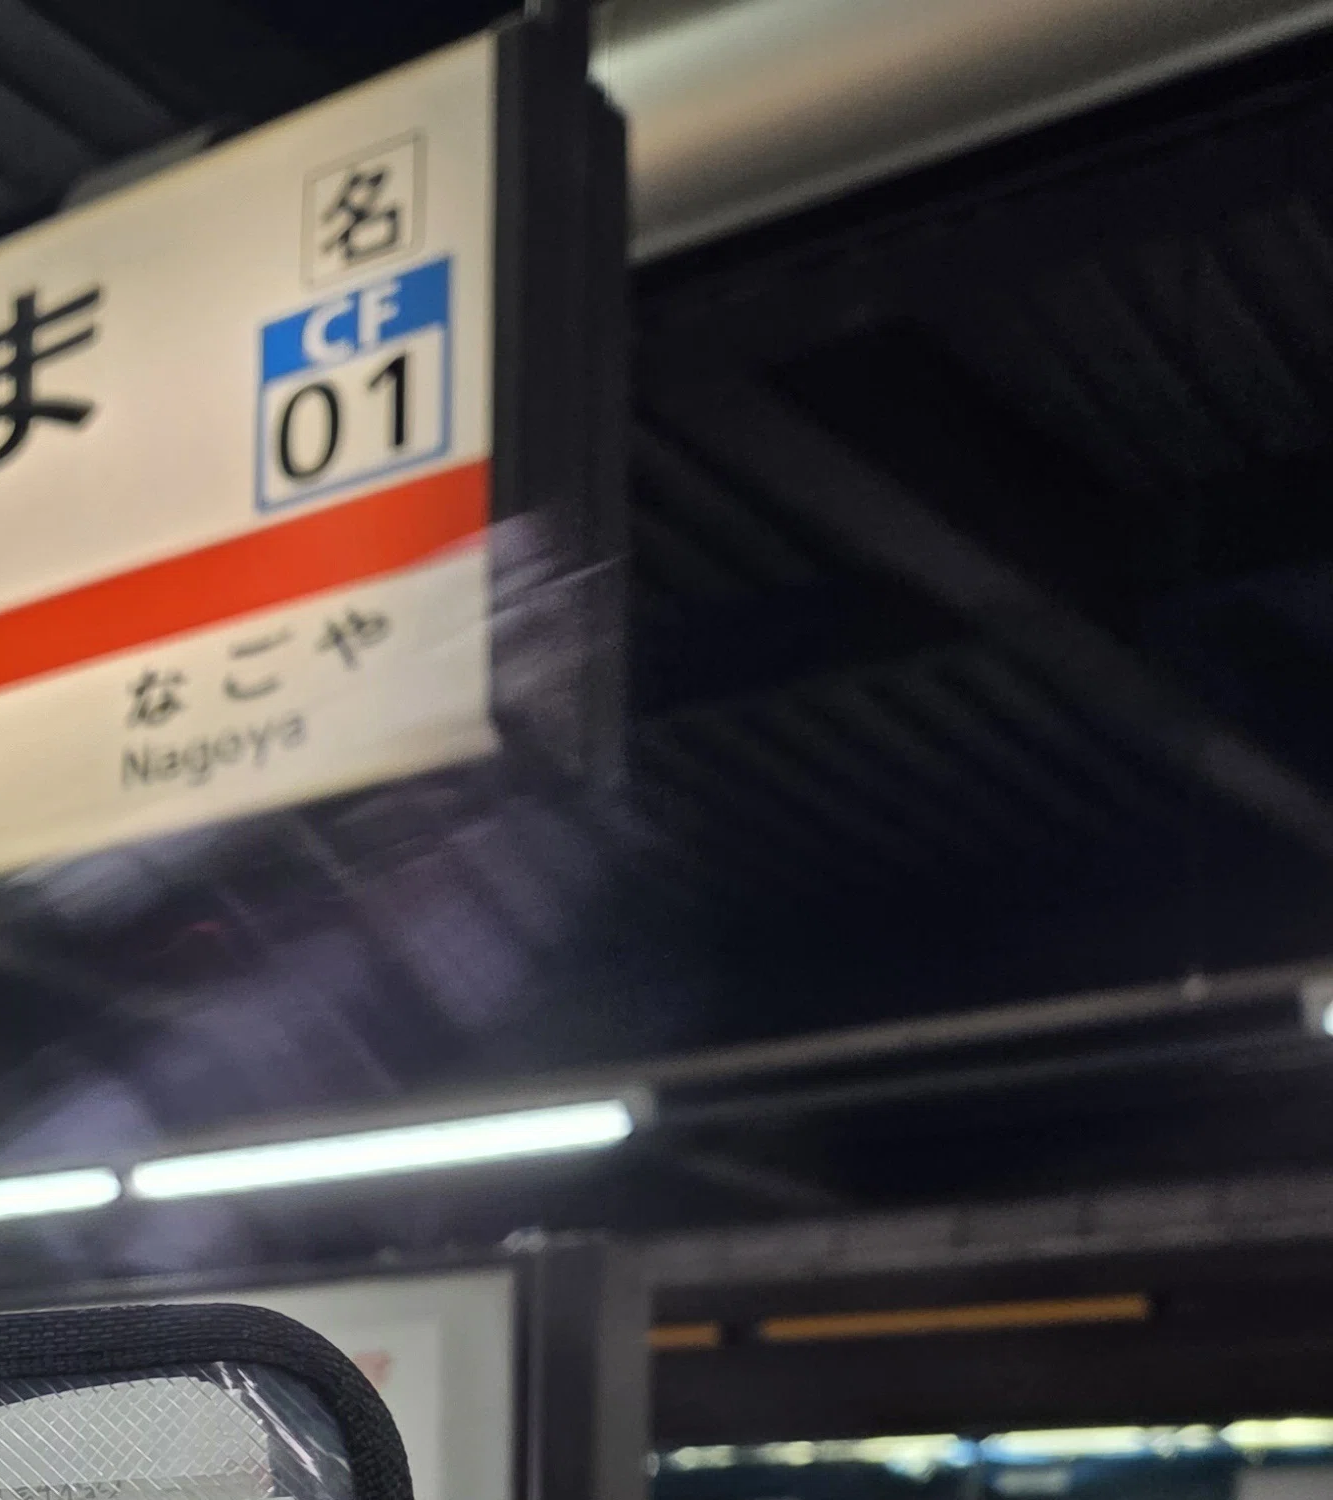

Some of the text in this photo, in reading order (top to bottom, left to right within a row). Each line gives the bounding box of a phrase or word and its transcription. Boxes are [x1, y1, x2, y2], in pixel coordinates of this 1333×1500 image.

[320, 166, 402, 263] 名
[302, 278, 403, 364] CF
[279, 351, 413, 481] 01
[120, 710, 309, 791] Nagoya
